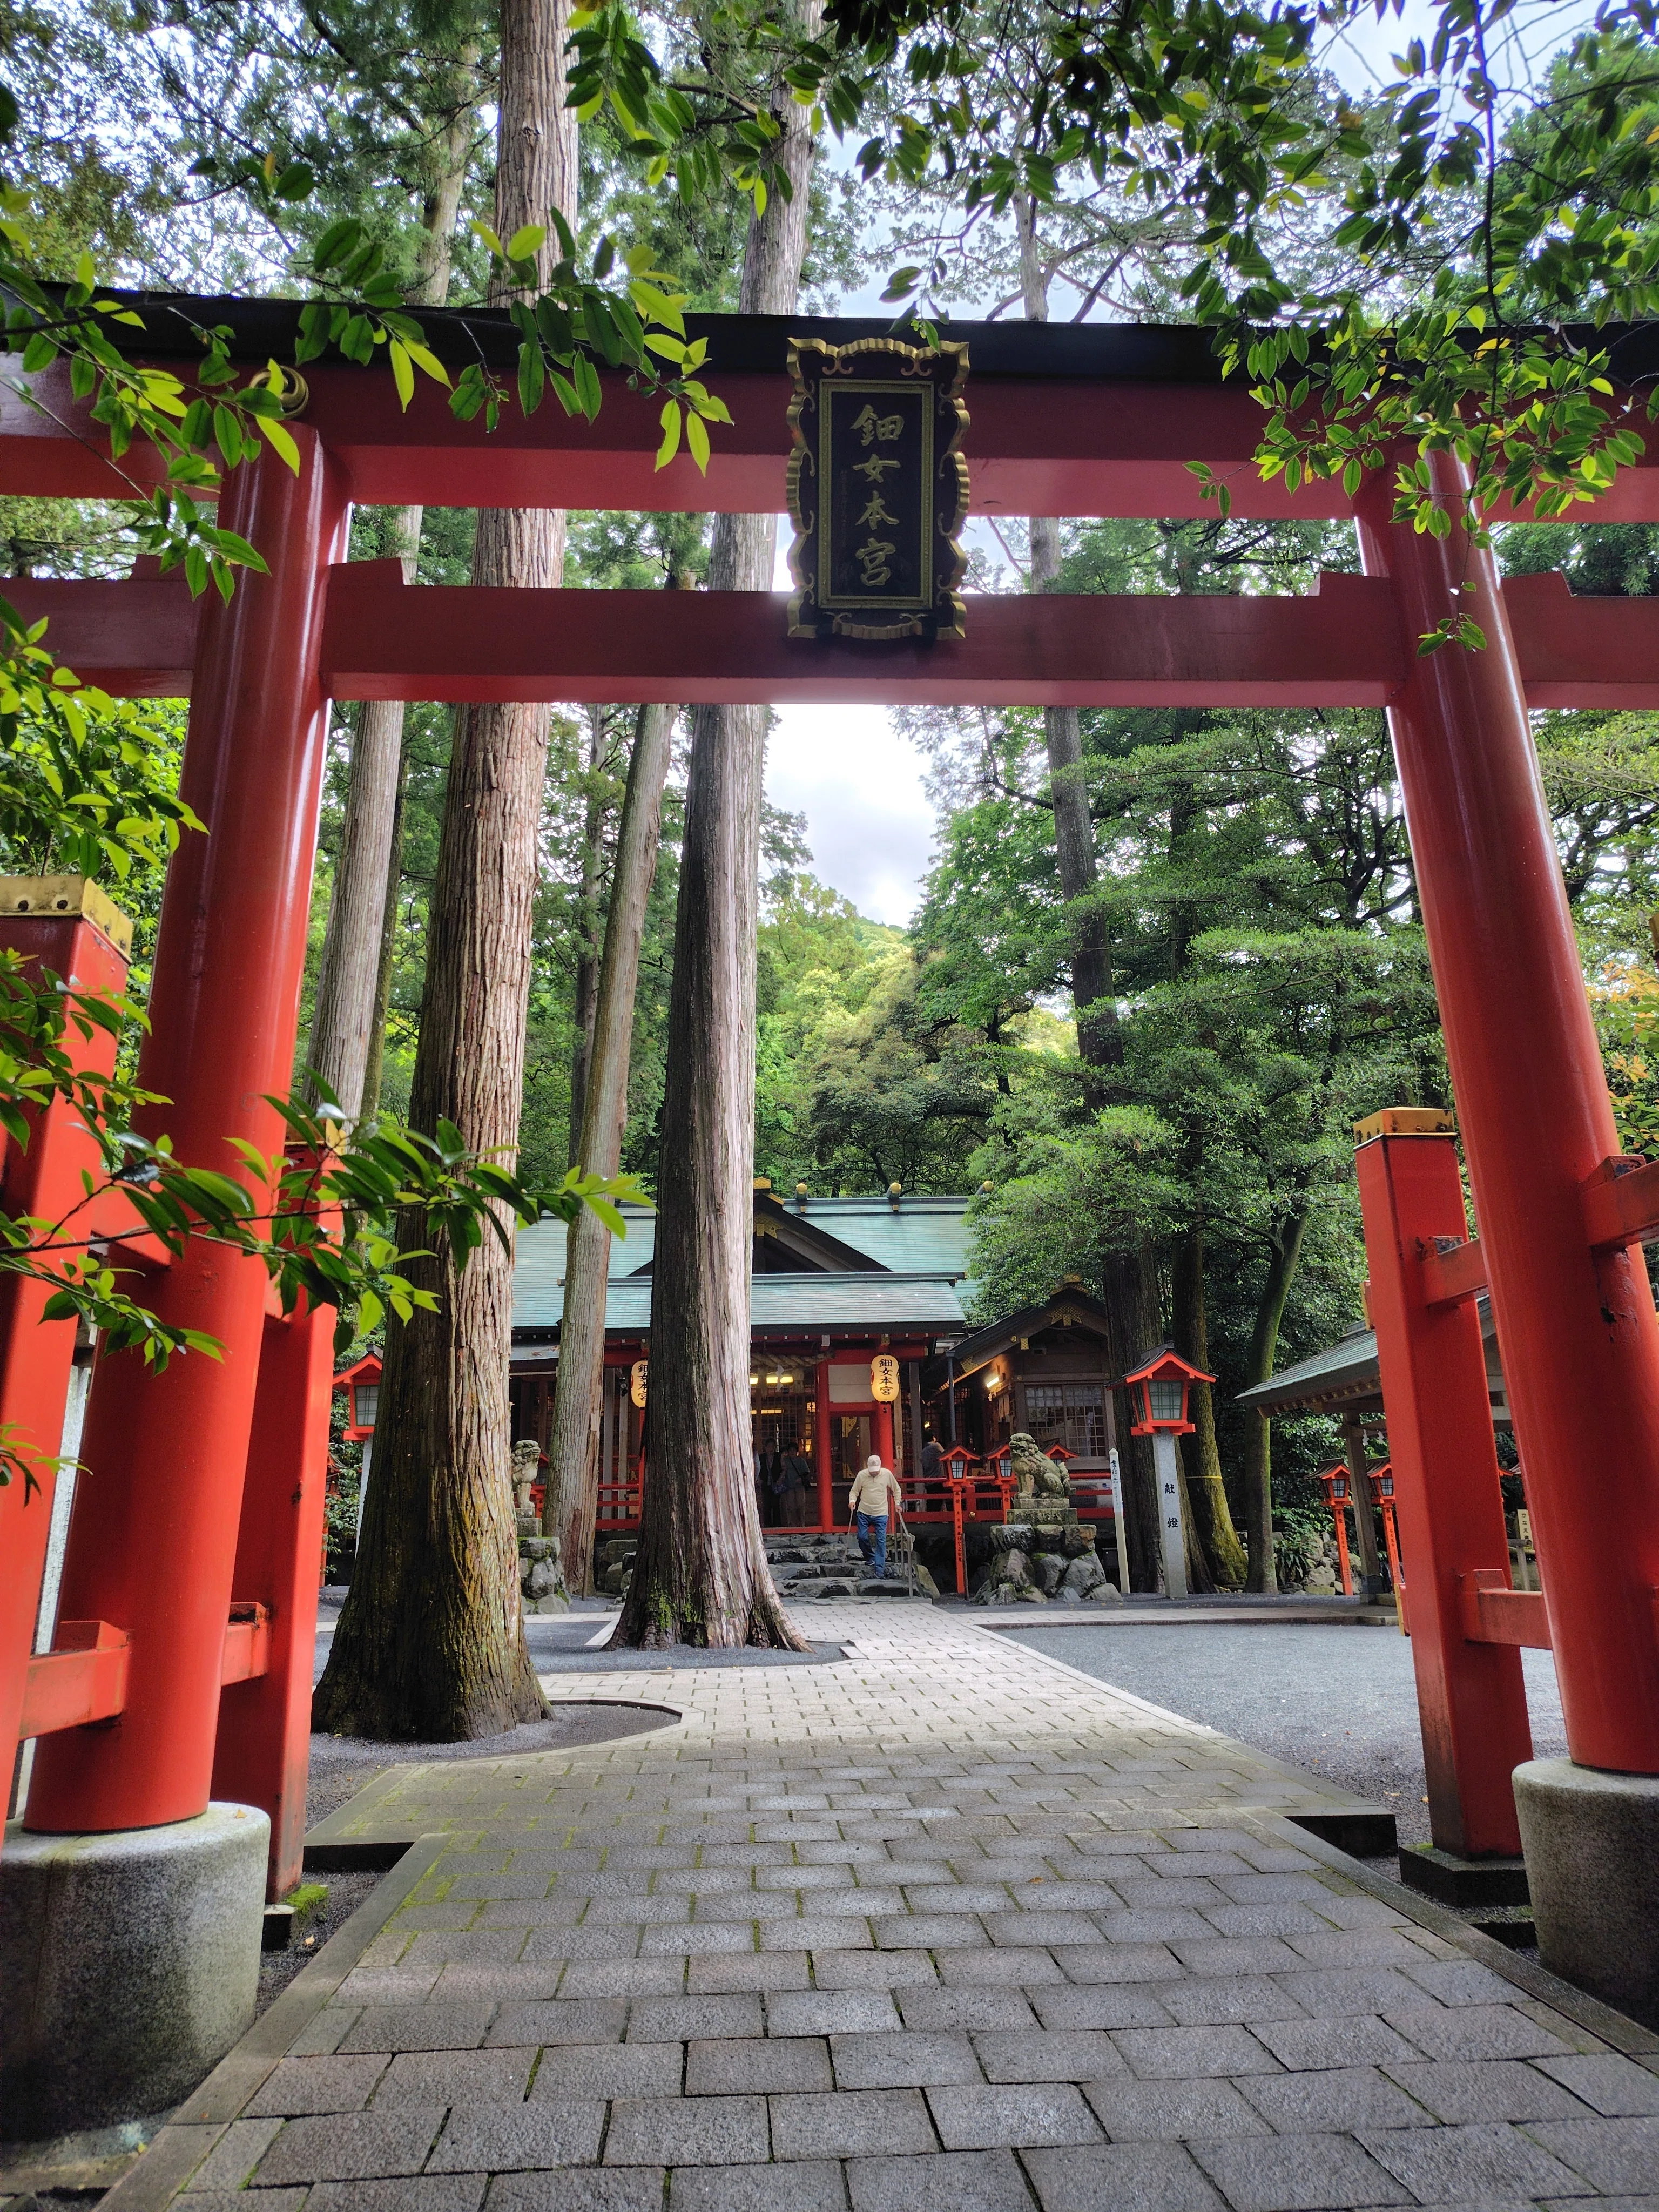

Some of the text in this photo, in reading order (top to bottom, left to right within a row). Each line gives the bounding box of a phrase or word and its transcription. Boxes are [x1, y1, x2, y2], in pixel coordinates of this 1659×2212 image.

[850, 404, 904, 586] 鈿女本宮
[879, 1359, 893, 1395] 鈿女本宮
[1165, 1483, 1178, 1527] 献燈
